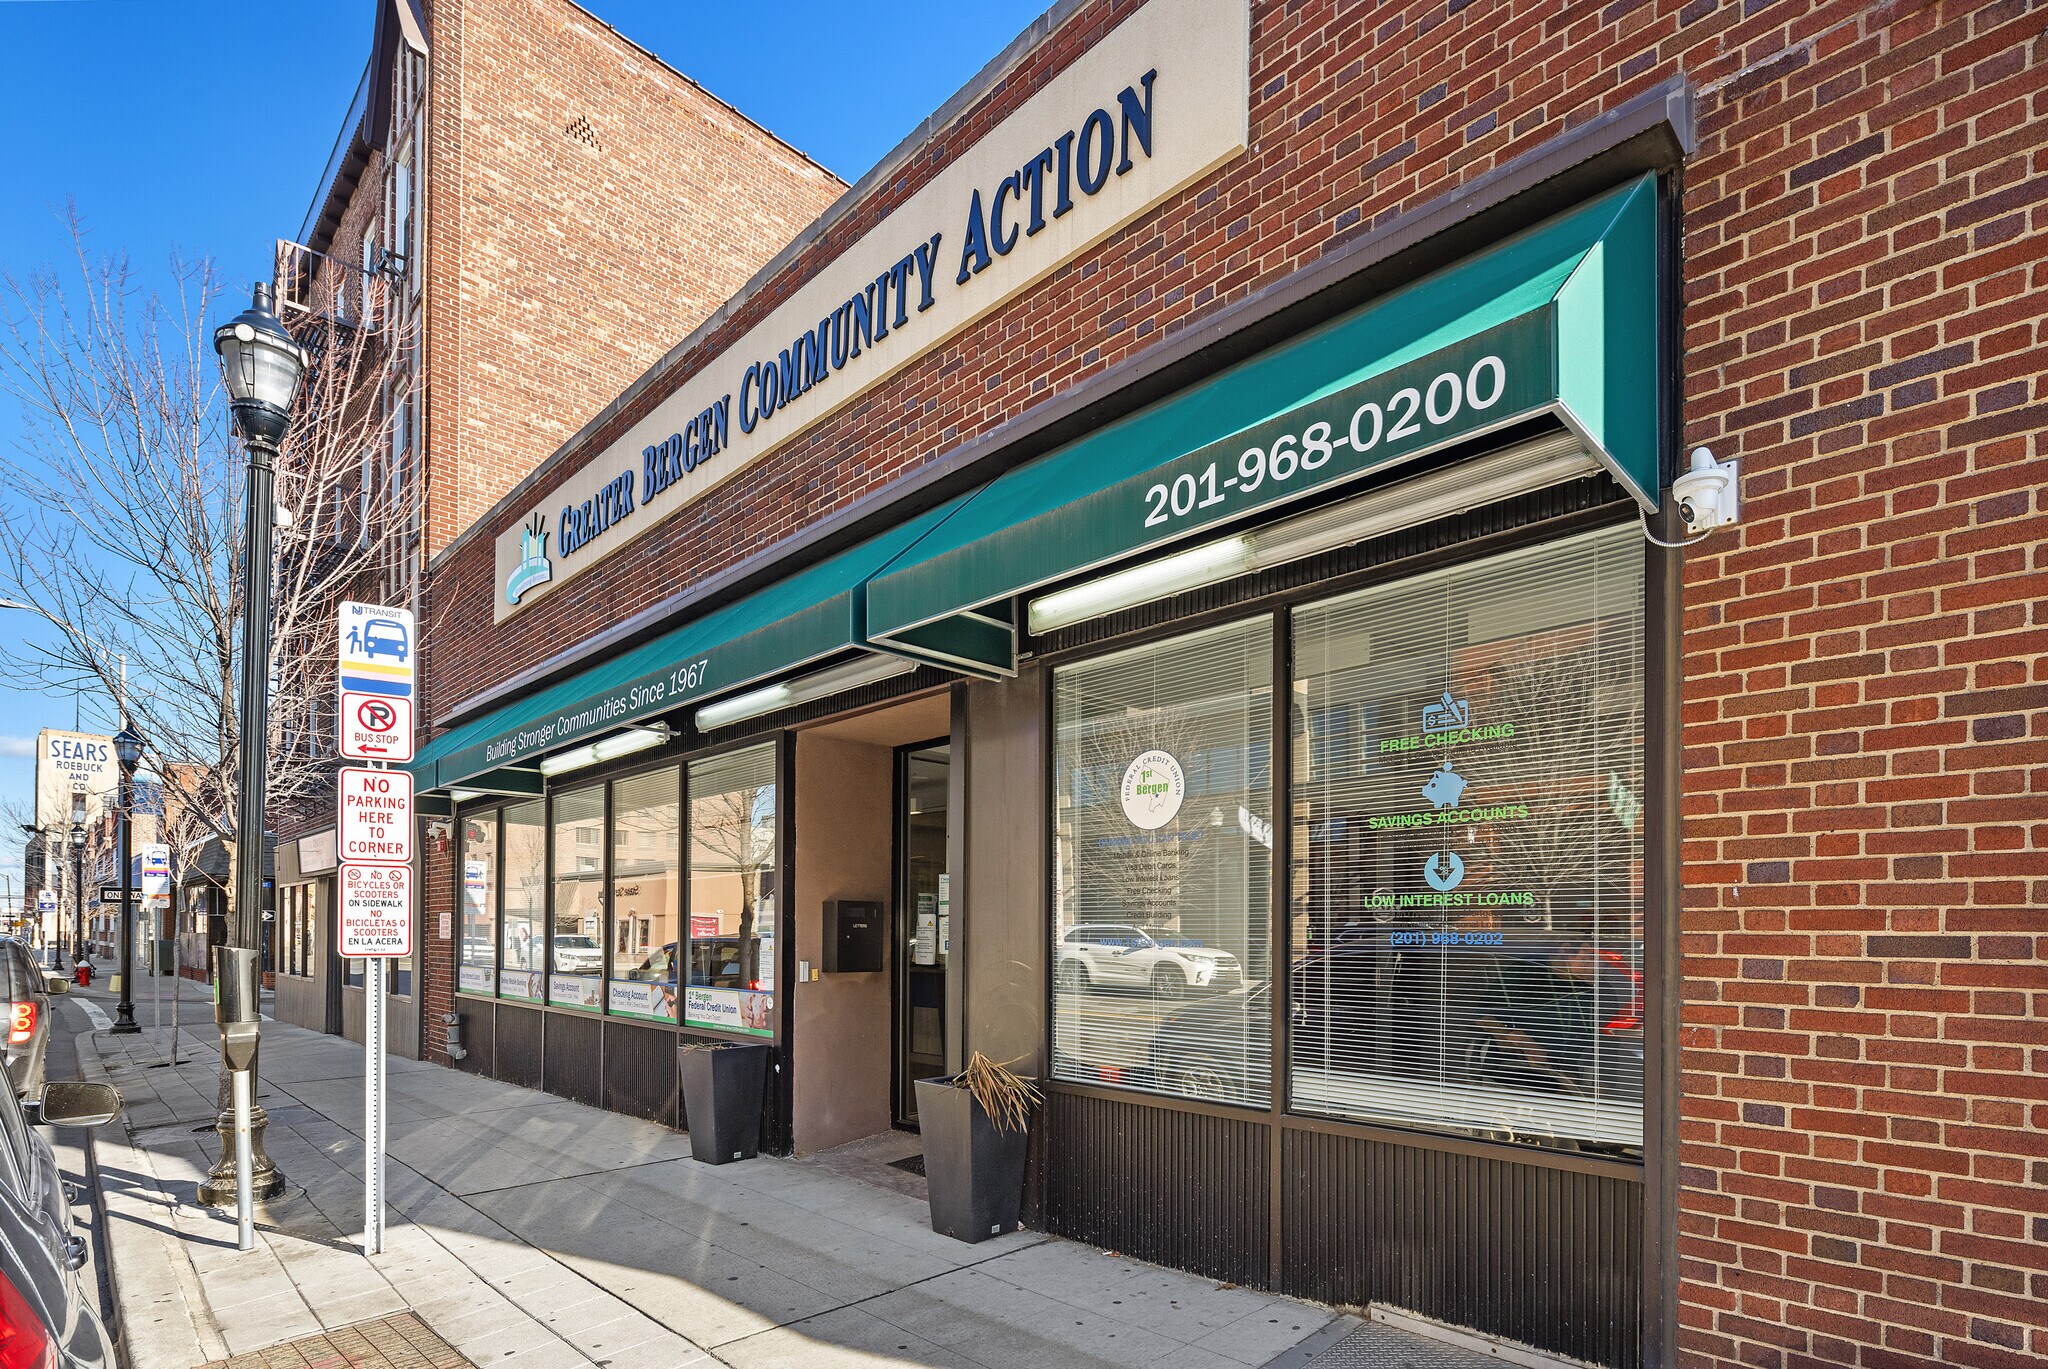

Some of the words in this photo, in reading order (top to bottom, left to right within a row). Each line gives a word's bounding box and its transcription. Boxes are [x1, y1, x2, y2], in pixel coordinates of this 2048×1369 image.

[557, 468, 635, 559] GREATER
[641, 393, 731, 505] BERGEN
[738, 232, 942, 434] COMMUNITY
[955, 68, 1158, 286] ACTION
[1144, 355, 1507, 528] 201-968-0200
[364, 607, 402, 619] TRANSIT
[486, 737, 517, 762] Building
[517, 721, 554, 746] Stronger
[557, 698, 627, 736] Communities
[629, 680, 664, 710] Since
[668, 659, 708, 696] 1967
[354, 732, 374, 743] BUS
[375, 734, 399, 745] STOP
[1380, 736, 1420, 753] FREE
[1424, 723, 1516, 748] CHECKING
[51, 740, 108, 762] SEARS
[56, 760, 103, 773] ROEBUCK
[68, 772, 89, 781] AND
[1125, 764, 1141, 802] FEDERAL
[1142, 755, 1171, 766] CREDIT
[1170, 765, 1181, 796] UNION
[1141, 769, 1153, 783] 1st
[363, 778, 390, 793] NO
[1136, 782, 1169, 796] Bergen
[347, 794, 406, 810] PARKING
[359, 811, 394, 825] HERE
[1368, 812, 1433, 830] SAVINGS
[1436, 805, 1529, 825] ACCOUNTS
[368, 826, 385, 839] TO
[349, 840, 404, 855] CORNER
[370, 872, 383, 880] NO
[347, 881, 391, 889] BICYCLES
[393, 881, 405, 890] OR
[1142, 887, 1172, 896] Checking
[354, 890, 399, 899] SCOOTERS
[1364, 895, 1396, 908] LOW
[1399, 893, 1473, 907] INTEREST
[1478, 892, 1534, 905] LOANS
[348, 899, 360, 907] ON
[362, 899, 403, 908] SIDEWALK
[370, 910, 383, 918] NO
[346, 919, 399, 927] BICICLETAS
[400, 919, 406, 928] O
[353, 928, 399, 937] SCOOTERS
[1390, 932, 1427, 947] (201)
[1431, 932, 1503, 945] 968-0202
[612, 987, 631, 1001] Checking
[631, 989, 648, 1001] Account
[695, 991, 712, 1003] Bergen
[688, 1000, 706, 1011] Federal
[706, 1002, 721, 1013] Credit
[722, 1003, 737, 1014] Union
